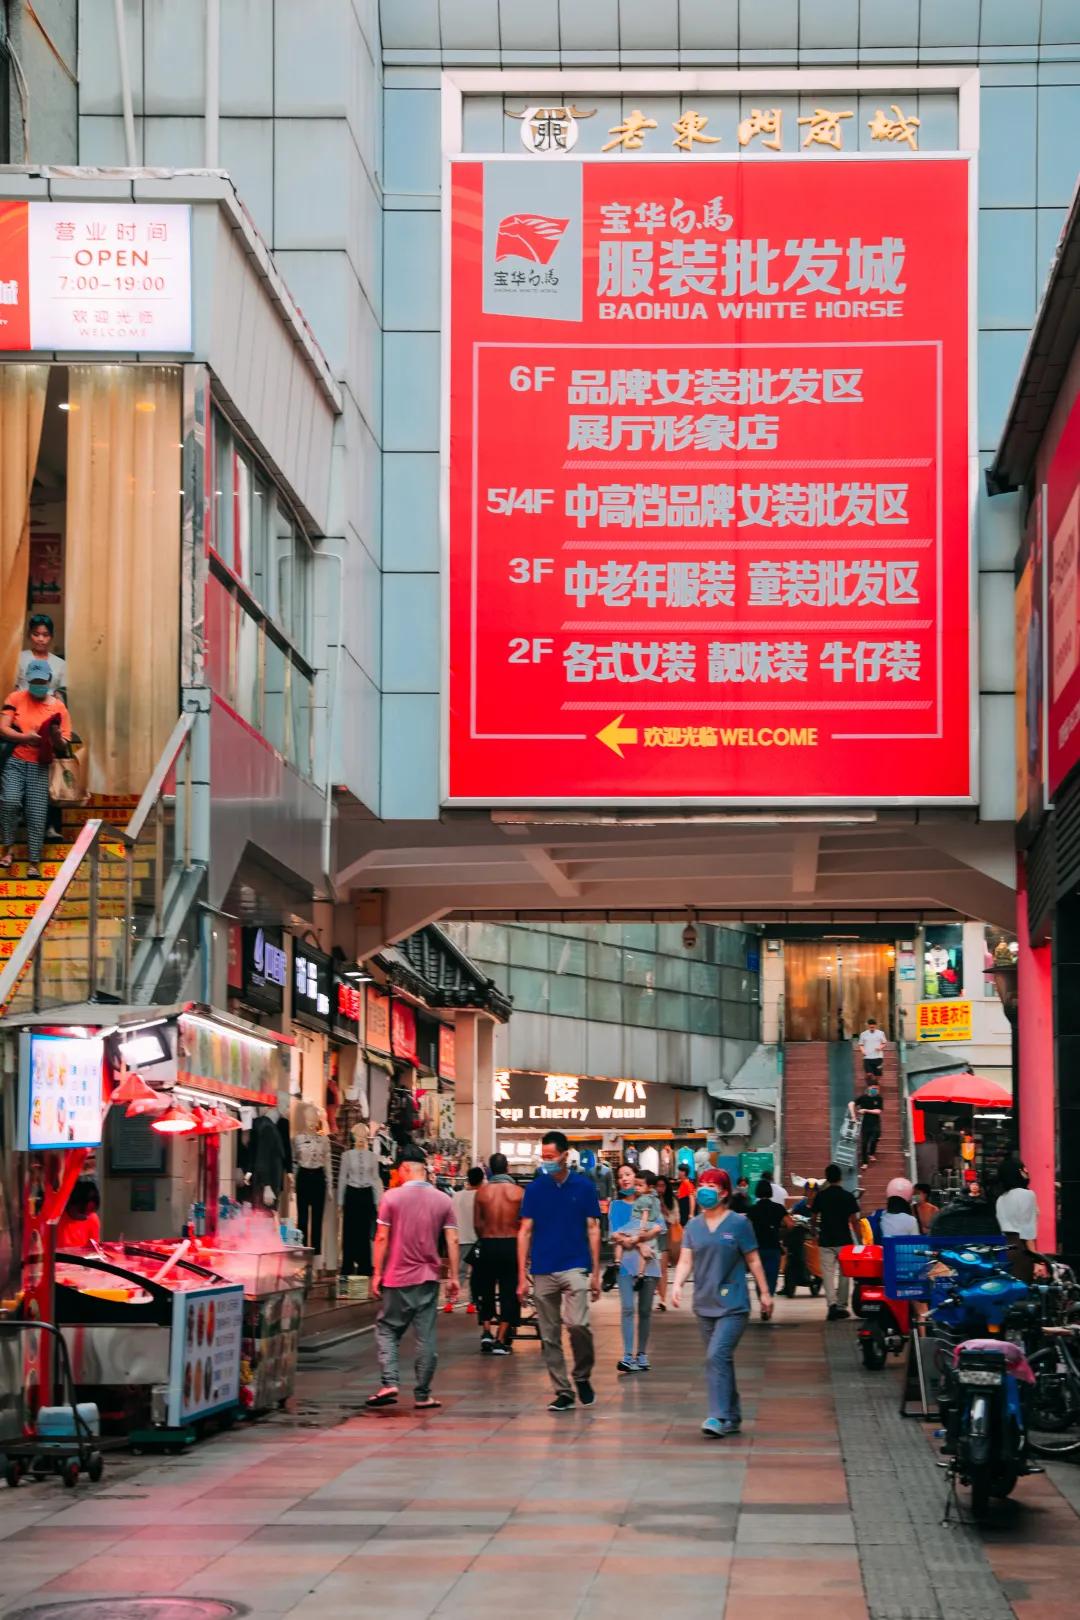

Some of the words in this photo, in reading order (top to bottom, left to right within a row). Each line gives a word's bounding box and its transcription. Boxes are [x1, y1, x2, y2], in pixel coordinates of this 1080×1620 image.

[56, 222, 167, 241] 营业时间
[75, 250, 148, 266] OPEN
[597, 237, 907, 297] 服装批发城
[73, 310, 153, 323] 欢迎光临
[599, 302, 709, 320] BAOHUA
[717, 301, 807, 319] WHITE
[815, 300, 904, 318] HORSE
[80, 328, 147, 337] WELCOME
[510, 366, 555, 392] 6F
[567, 367, 864, 406] 品牌女装批发区
[567, 414, 779, 452] 展厅形象店
[487, 488, 554, 516] 5/4F
[565, 483, 909, 529] 中高档品牌女装批发区
[508, 558, 554, 584] 3F
[564, 560, 736, 608] 中老年服装
[747, 560, 920, 608] 童装批发区
[508, 638, 553, 664] 2F
[563, 641, 696, 684] 各式女装
[707, 641, 809, 684] 靓妹装
[819, 640, 921, 683] 牛仔装
[643, 726, 717, 749] 欢迎光临
[719, 727, 818, 746] WELCOME
[529, 1105, 589, 1121] Cherry
[595, 1105, 646, 1119] Wood
